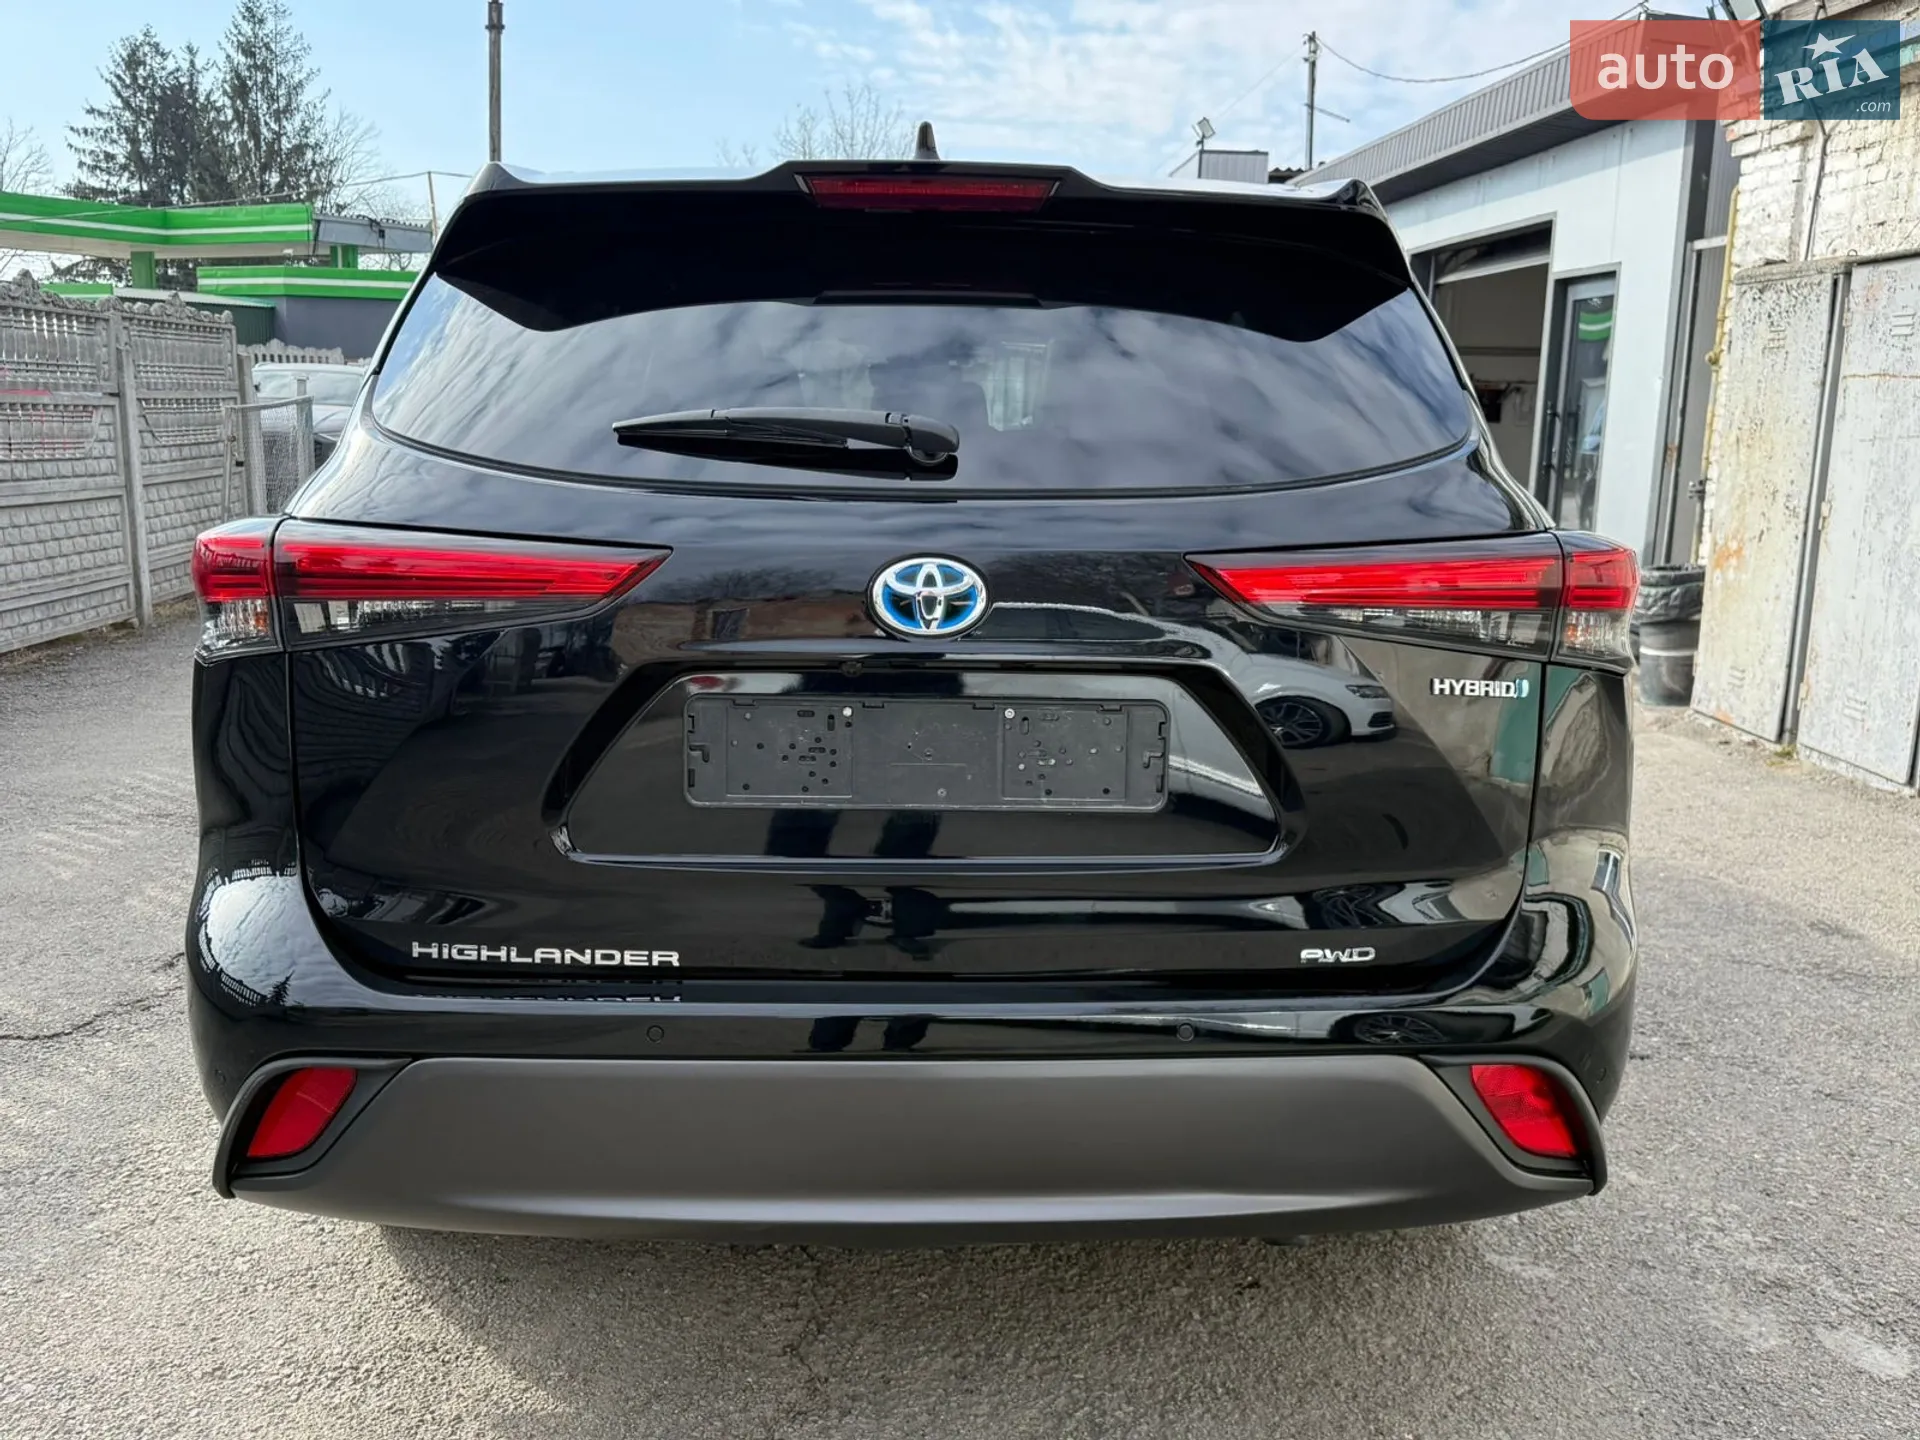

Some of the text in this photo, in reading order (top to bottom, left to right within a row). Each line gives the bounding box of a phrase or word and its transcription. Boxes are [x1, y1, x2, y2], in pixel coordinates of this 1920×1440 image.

[1432, 678, 1516, 698] HYBRID
[411, 941, 681, 967] HIGHLANDER
[1300, 947, 1376, 963] AWD
